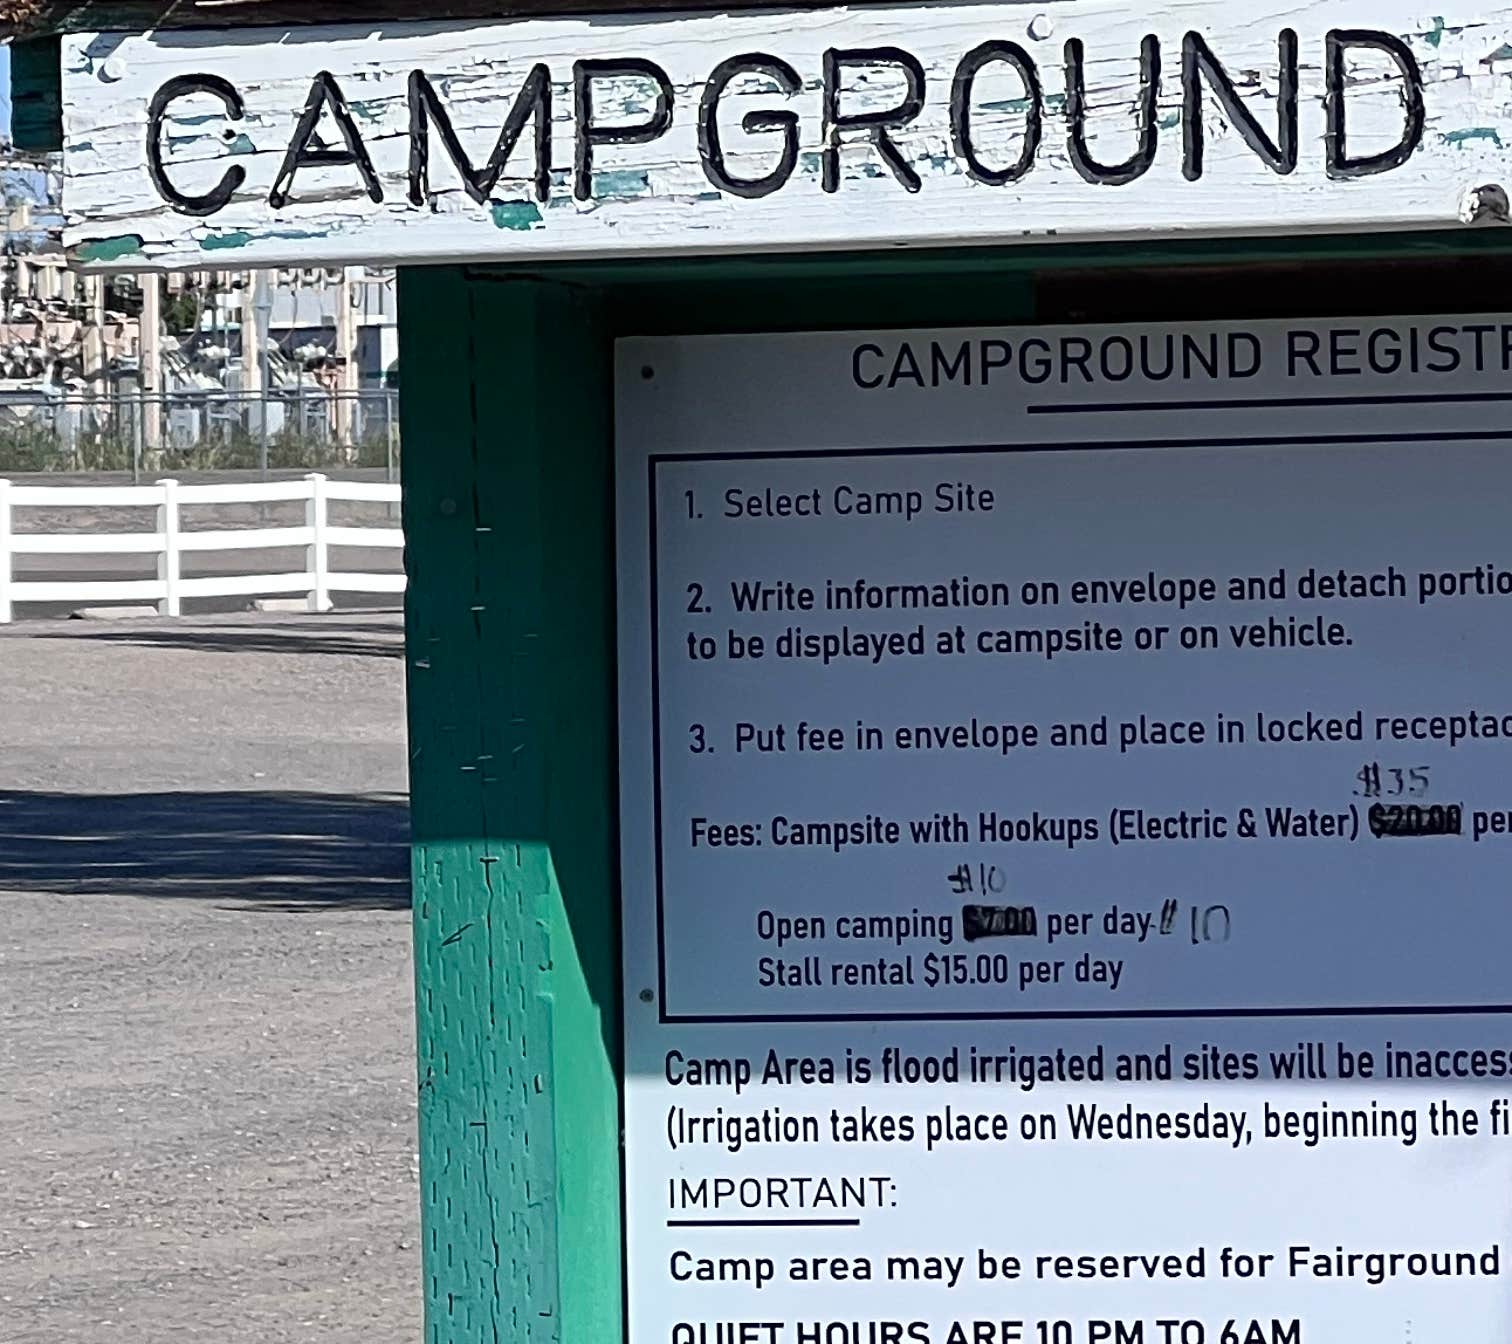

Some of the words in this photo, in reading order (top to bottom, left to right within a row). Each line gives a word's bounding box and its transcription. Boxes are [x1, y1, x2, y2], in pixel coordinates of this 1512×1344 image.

[146, 28, 1426, 215] CAMPGROUND
[853, 332, 1261, 389] CAMPGROUND
[685, 490, 703, 519] 1.
[724, 488, 821, 518] Select
[834, 486, 922, 521] Camp
[935, 481, 994, 512] Site
[687, 583, 712, 613] 2.
[731, 581, 814, 612] Write
[826, 576, 1009, 610] information
[1021, 583, 1059, 605] on
[1071, 572, 1216, 610] envelope
[1222, 569, 1285, 600] and
[1298, 566, 1406, 599] detach
[689, 724, 714, 753] 3.
[736, 723, 786, 752] Put
[797, 722, 844, 751] fee
[857, 720, 883, 750] in
[895, 718, 1038, 755] envelope
[1050, 716, 1107, 746] and
[1120, 715, 1205, 753] place
[1218, 713, 1244, 743] in
[1258, 711, 1362, 742] locked
[691, 818, 761, 847] Fees:
[772, 815, 899, 853] Campsite
[909, 813, 968, 844] with
[979, 812, 1099, 849] Hookups
[1110, 808, 1227, 845] (Electric
[1237, 808, 1258, 837] &
[1265, 804, 1358, 841] Water)
[758, 911, 826, 955] Open
[836, 908, 953, 949] camping
[1048, 913, 1099, 948] per
[1103, 905, 1156, 942] day
[666, 1050, 750, 1095] Camp
[761, 1049, 834, 1084] Area
[846, 1048, 871, 1084] is
[882, 1046, 958, 1083] flood
[970, 1045, 1111, 1091] irrigated
[1115, 1044, 1181, 1081] and
[1182, 1044, 1259, 1080] sites
[1269, 1042, 1328, 1079] will
[1337, 1042, 1374, 1078] be
[668, 1105, 818, 1152] (Irrigation
[830, 1106, 914, 1142] takes
[927, 1105, 1008, 1151] place
[1020, 1114, 1056, 1140] on
[1067, 1103, 1251, 1148] Wednesday,
[1265, 1100, 1416, 1147] beginning
[1429, 1100, 1478, 1136] the
[670, 1177, 896, 1208] IMPORTANT:
